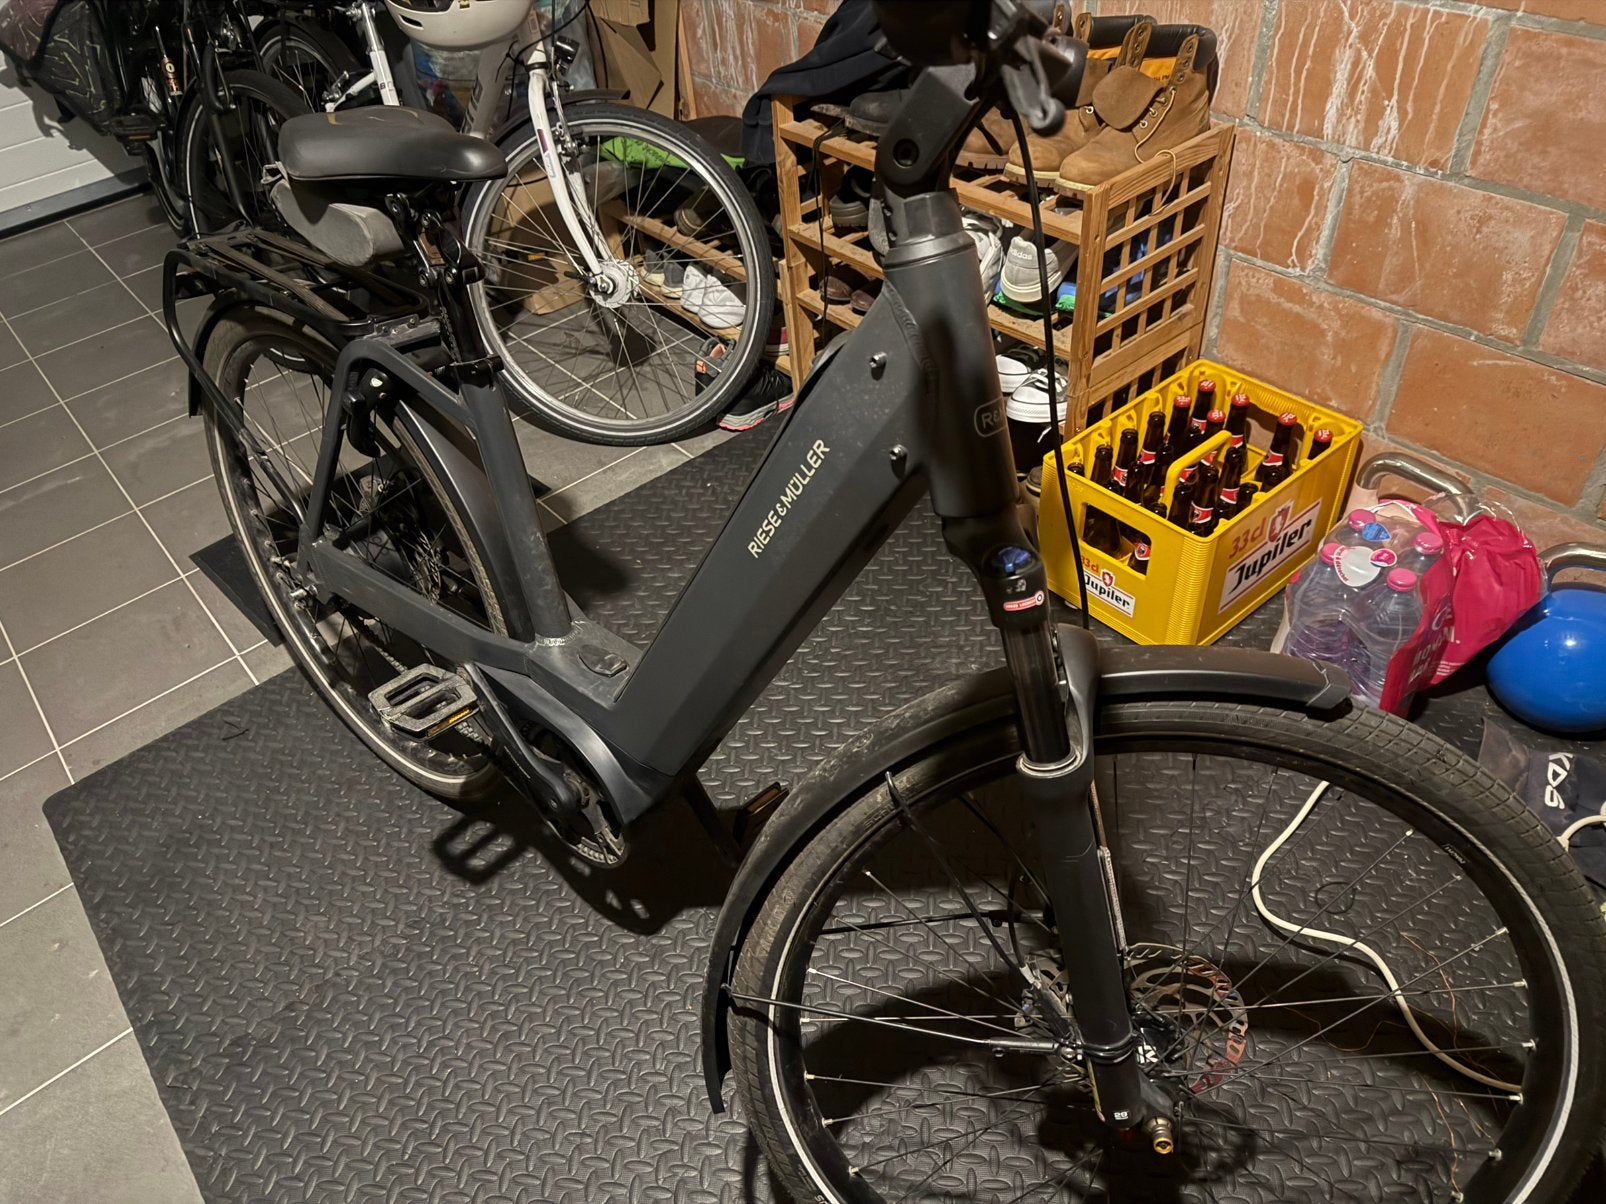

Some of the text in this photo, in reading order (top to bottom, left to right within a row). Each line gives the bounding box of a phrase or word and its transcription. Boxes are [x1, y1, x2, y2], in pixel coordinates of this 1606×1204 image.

[747, 439, 830, 558] RIESE & MÜLLER
[1228, 519, 1312, 594] Jupiler
[1229, 517, 1267, 559] 33cl
[1084, 573, 1130, 607] Jupiler
